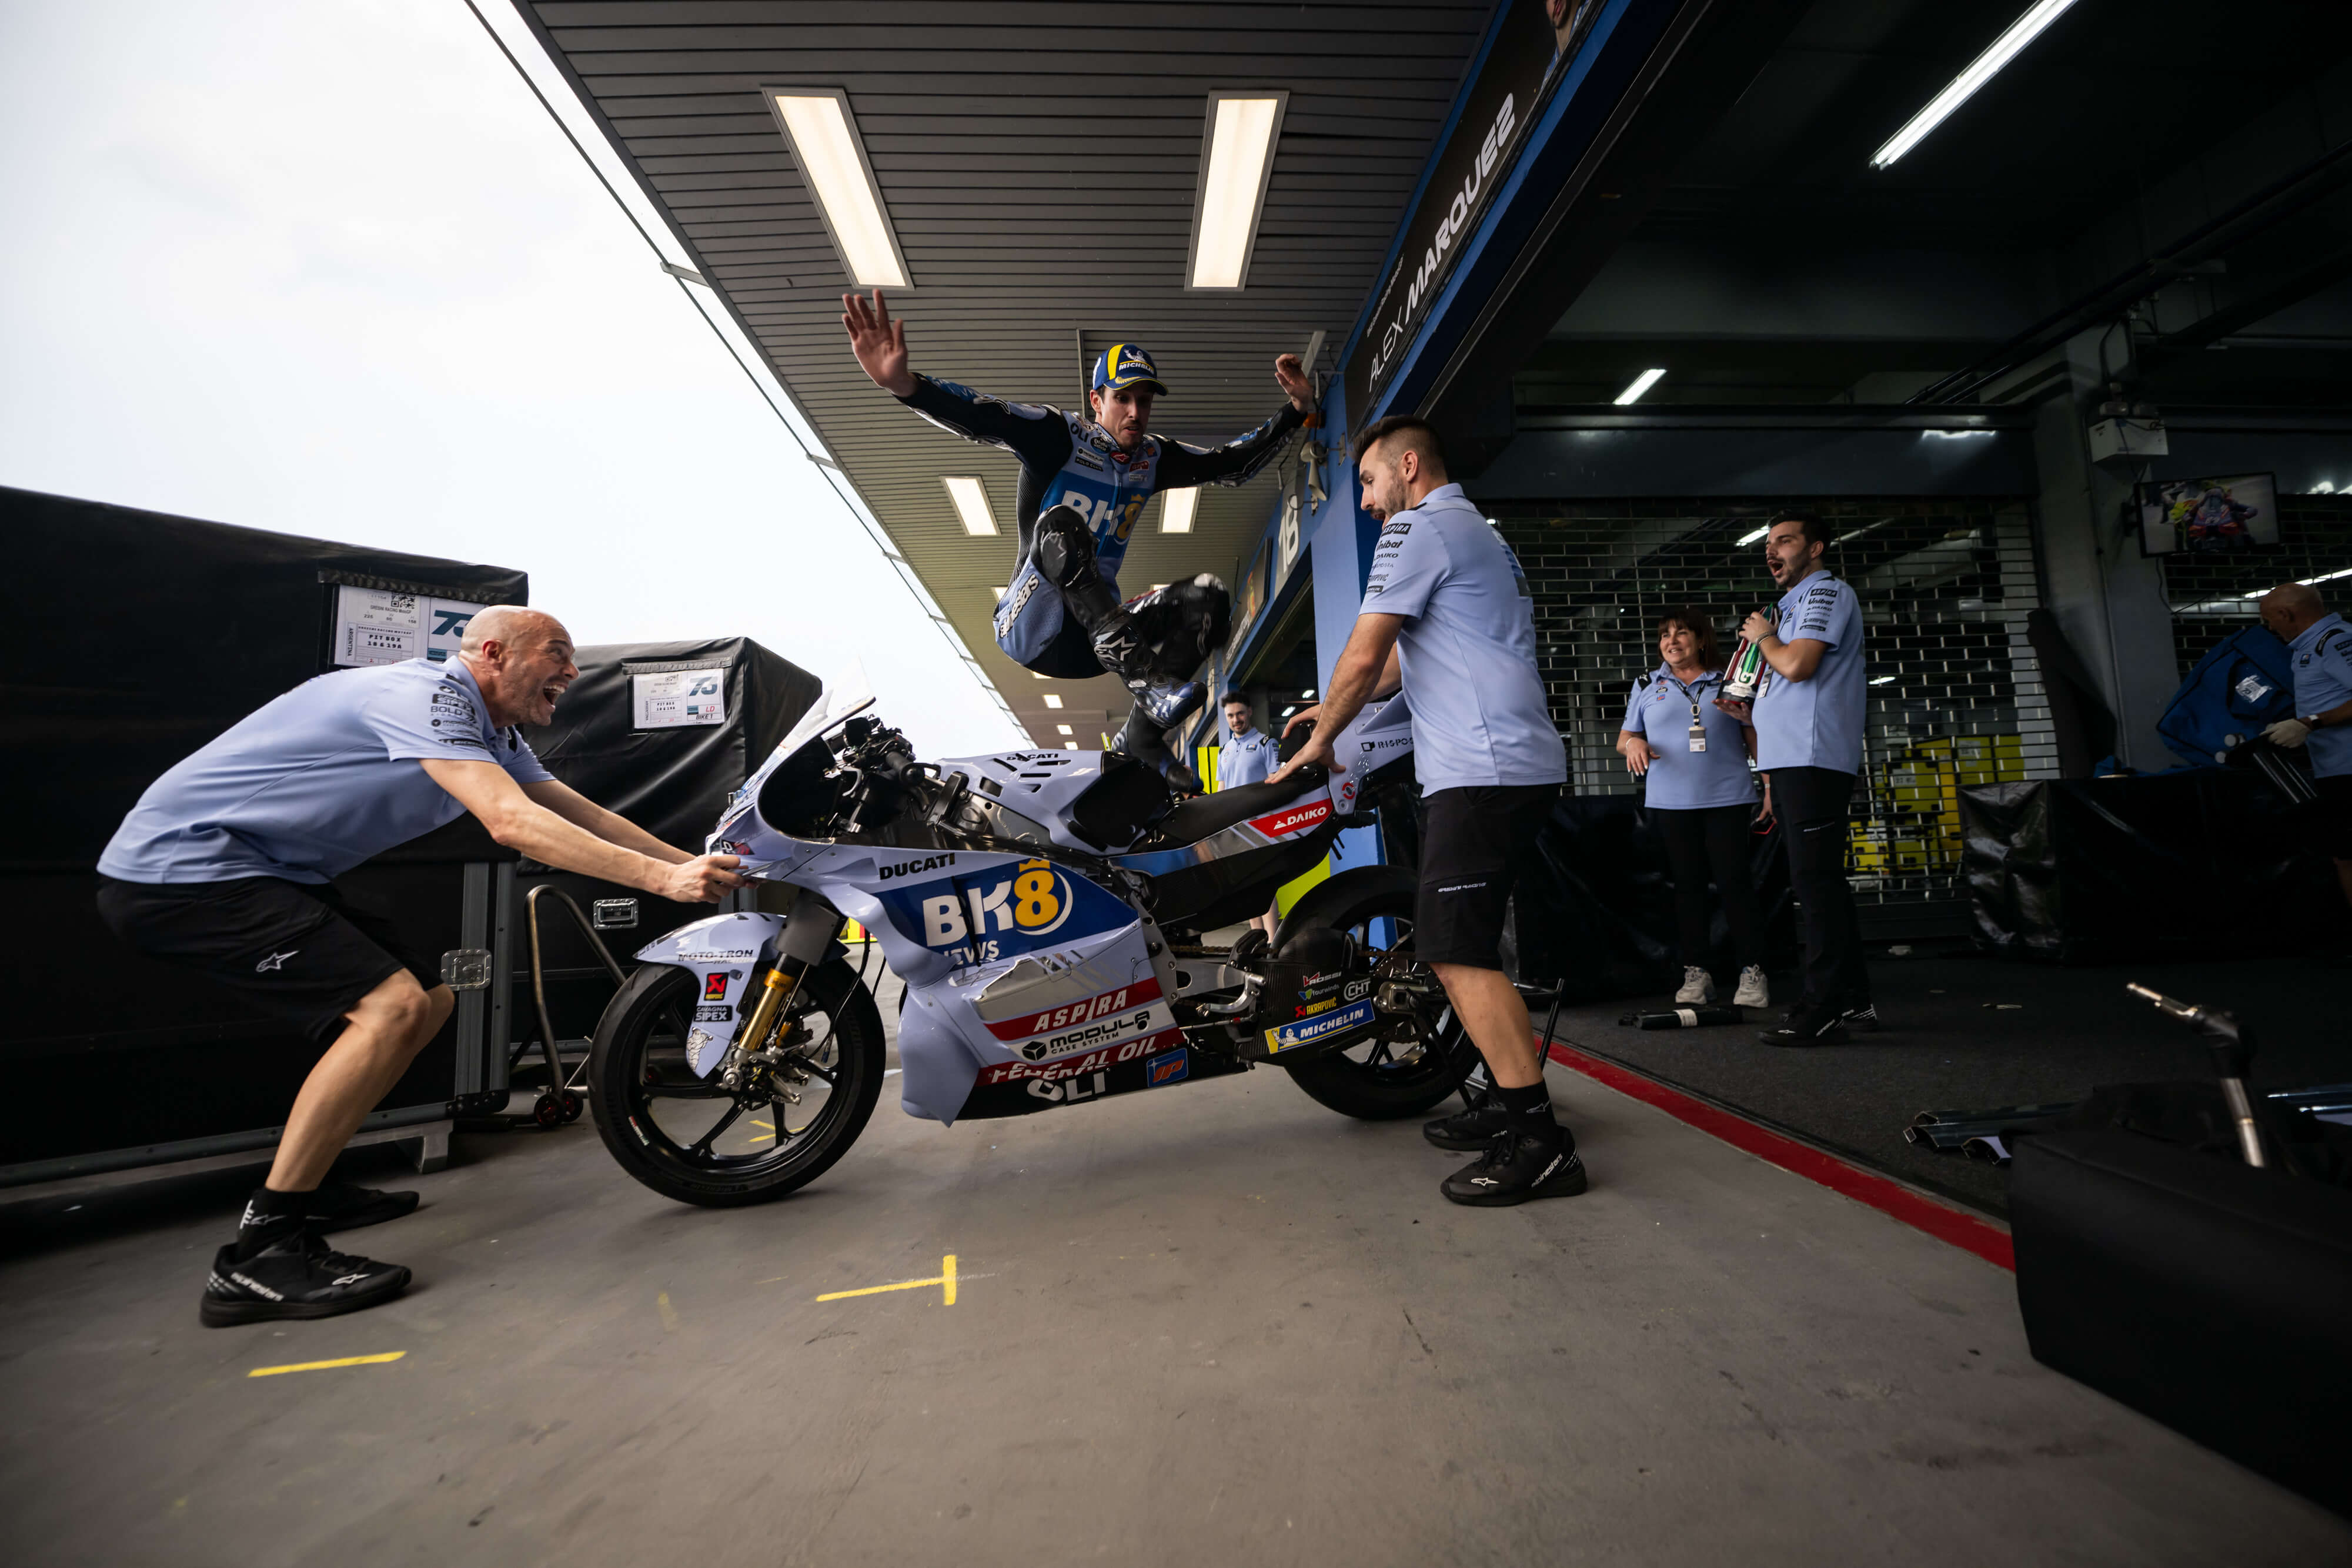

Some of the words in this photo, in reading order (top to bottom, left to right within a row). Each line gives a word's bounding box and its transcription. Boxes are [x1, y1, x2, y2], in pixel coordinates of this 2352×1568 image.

[1369, 305, 1403, 393] ALEX
[1070, 422, 1088, 443] OLI
[1278, 495, 1299, 574] 18
[430, 706, 463, 716] BOLD
[1287, 807, 1327, 826] DAIKO
[879, 852, 956, 881] DUCATI
[922, 869, 1060, 947] BK8
[943, 940, 1000, 965] EWS
[695, 1011, 727, 1021] SIPEX
[1033, 989, 1127, 1033] ASPIRA
[1300, 1008, 1364, 1038] MICHELIN
[1051, 1044, 1077, 1054] CASE
[1083, 1032, 1119, 1047] SYSTEM
[1117, 1037, 1157, 1062] OIL
[1027, 1071, 1106, 1102] OLI
